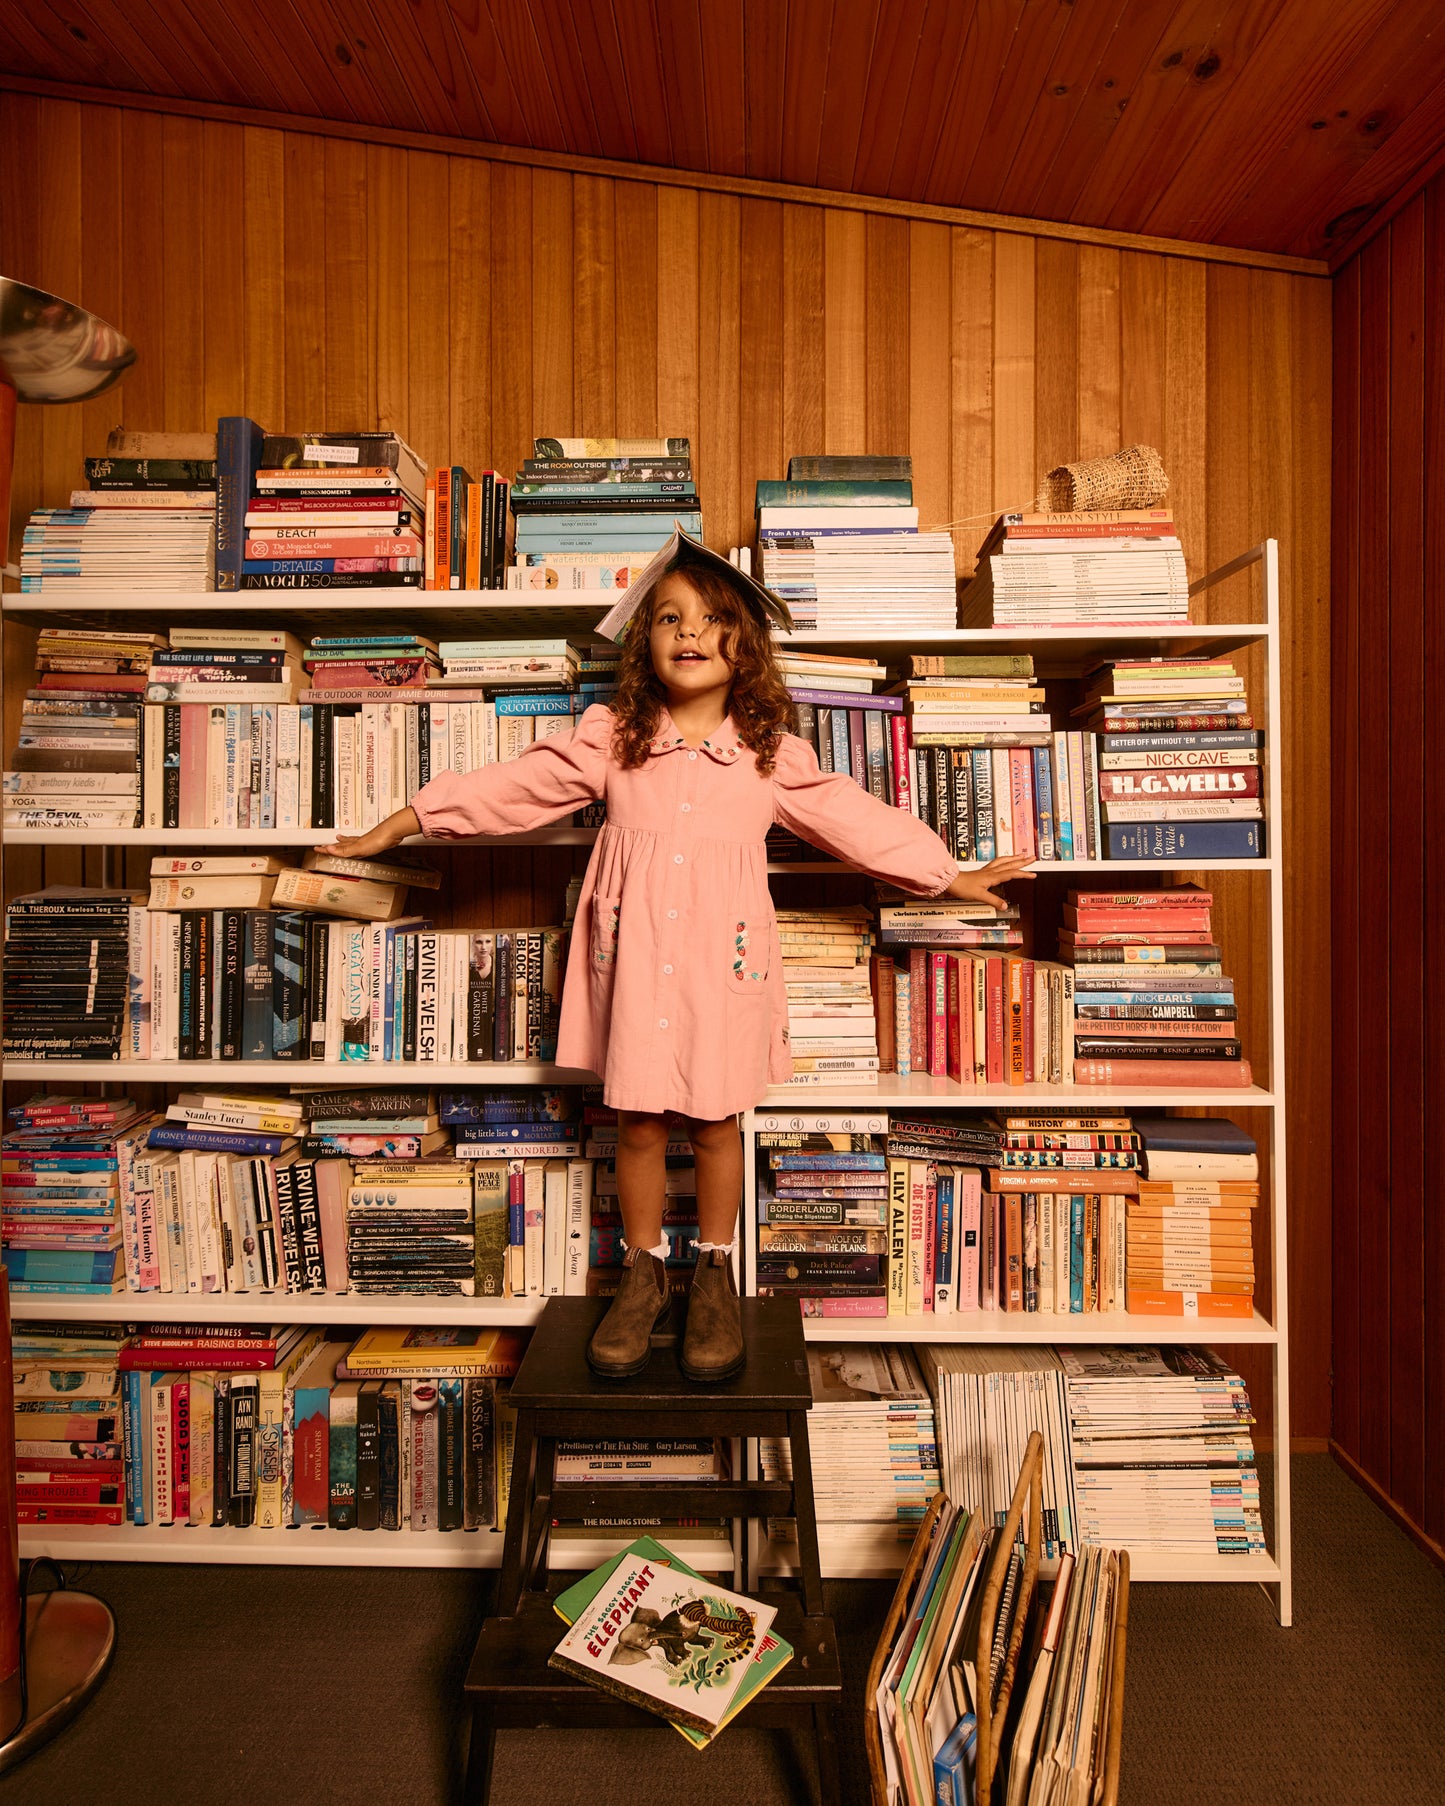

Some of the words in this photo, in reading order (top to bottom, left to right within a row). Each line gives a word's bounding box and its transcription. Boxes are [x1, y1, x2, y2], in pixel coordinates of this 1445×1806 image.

[218, 476, 231, 550] BIRTHDAYS
[1047, 514, 1079, 523] JAPAN
[1088, 513, 1122, 521] STYLE
[277, 529, 316, 537] BEACH
[272, 561, 323, 572] DETAILS
[553, 555, 599, 563] waterside
[604, 554, 630, 563] living
[247, 575, 262, 588] IN
[264, 575, 310, 588] VOGUE
[311, 575, 331, 587] 50
[325, 691, 362, 699] OUTDOOR
[367, 690, 392, 699] ROOM
[397, 690, 422, 698] JAMIE
[425, 689, 449, 697] DURIE
[500, 702, 568, 713] QUOTATIONS
[1146, 754, 1184, 766] NICK
[1187, 752, 1229, 765] CAVE
[40, 777, 72, 788] anthony
[75, 777, 95, 786] kiedis
[976, 760, 992, 808] PATTERSON
[1040, 766, 1048, 784] Ben
[1111, 773, 1247, 793] H.G.WELLS
[12, 798, 36, 806] YOGA
[956, 770, 968, 818] STEPHEN
[1040, 786, 1049, 809] Elton
[46, 809, 82, 819] DEVIL
[957, 822, 969, 848] KING
[1153, 825, 1163, 856] Oscar
[1166, 825, 1176, 854] Wilde
[96, 906, 111, 914] Tong
[228, 916, 238, 952] GREAT
[906, 921, 924, 929] sugar
[350, 933, 362, 968] SAGA
[516, 938, 526, 980] BLOCK
[227, 955, 236, 974] SEX
[422, 934, 436, 993] IRVINE
[350, 973, 361, 1016] LAND
[472, 991, 481, 1037] GARDENIA
[1152, 1006, 1195, 1018] CAMPBELL
[182, 1008, 190, 1037] HAYNES
[420, 998, 434, 1062] WELSH
[1012, 1016, 1022, 1042] IRVINE
[818, 1061, 855, 1069] coonardoo
[1013, 1045, 1022, 1072] WELSH
[27, 1107, 52, 1116] Italian
[184, 1109, 217, 1123] Stanley
[220, 1113, 244, 1124] Tucci
[262, 1121, 279, 1129] Taste
[35, 1116, 66, 1126] Spanish
[1080, 1120, 1099, 1128] BEES
[465, 1130, 476, 1139] big
[478, 1129, 496, 1137] little
[497, 1128, 508, 1137] lies
[896, 1124, 928, 1133] BLOOD
[929, 1128, 958, 1137] MONEY
[958, 1132, 975, 1140] Arden
[977, 1134, 996, 1142] Winch
[514, 1146, 559, 1155] KINDRED
[478, 1179, 500, 1187] PEACE
[894, 1172, 904, 1204] LILY
[295, 1163, 316, 1222] IRVINE
[912, 1184, 925, 1201] ZOË
[141, 1198, 151, 1224] Nick
[770, 1205, 838, 1214] BORDERLANDS
[912, 1203, 922, 1240] FOSTER
[892, 1208, 904, 1259] ALLEN
[141, 1226, 154, 1265] Hornby
[302, 1224, 323, 1291] WELSH
[150, 1325, 183, 1334] COOKING
[185, 1326, 203, 1335] WITH
[206, 1328, 242, 1337] KINDNESS
[197, 1340, 235, 1348] RAISING
[237, 1340, 262, 1348] BOYS
[451, 1364, 511, 1375] AUSTRALIA
[238, 1400, 250, 1413] AYN
[236, 1416, 252, 1430] RAND
[473, 1388, 483, 1451] PASSAGE
[331, 1488, 355, 1496] SLAP
[583, 1518, 597, 1526] THE
[599, 1518, 631, 1526] ROLLING
[632, 1517, 661, 1525] STONES
[583, 1626, 600, 1642] THE
[597, 1596, 619, 1624] SAGGY
[618, 1570, 638, 1598] BAGGY
[586, 1564, 655, 1658] ELEPHANT
